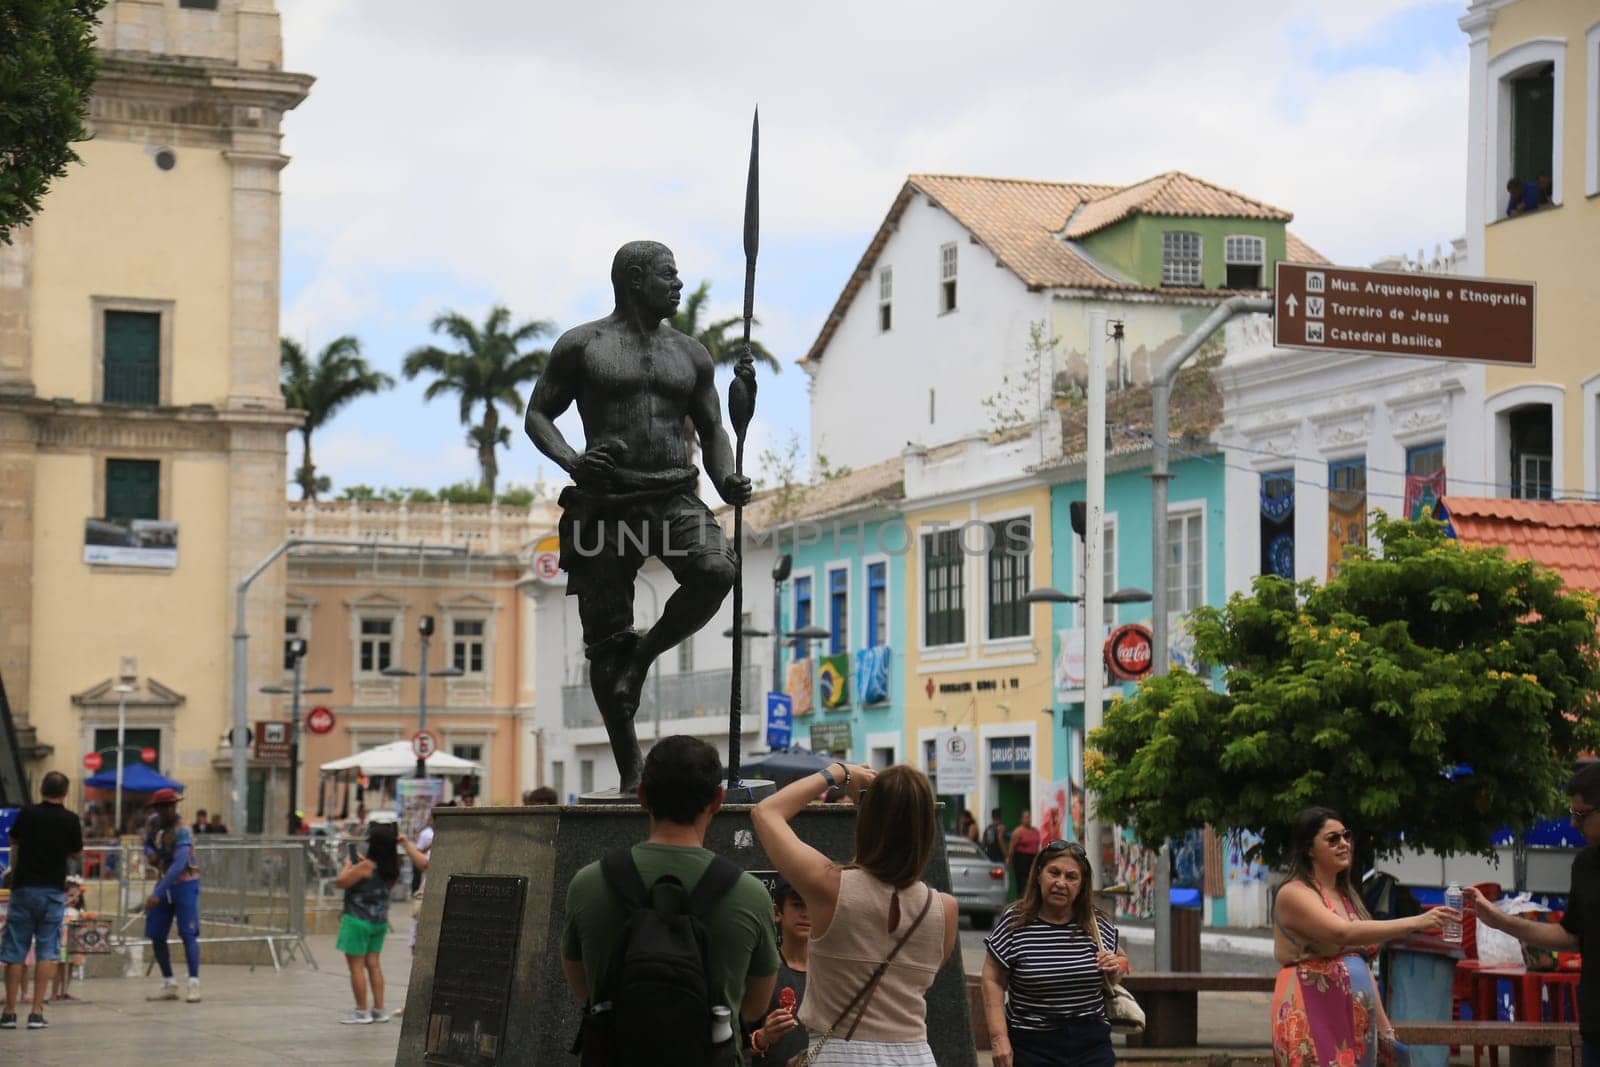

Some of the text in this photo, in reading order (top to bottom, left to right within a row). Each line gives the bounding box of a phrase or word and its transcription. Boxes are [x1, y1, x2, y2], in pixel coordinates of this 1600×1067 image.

[1331, 278, 1527, 307] Mus. Arqueologia e Etnografia
[1331, 302, 1450, 325] Terreiro de Jesus
[1330, 327, 1386, 344] Catedral
